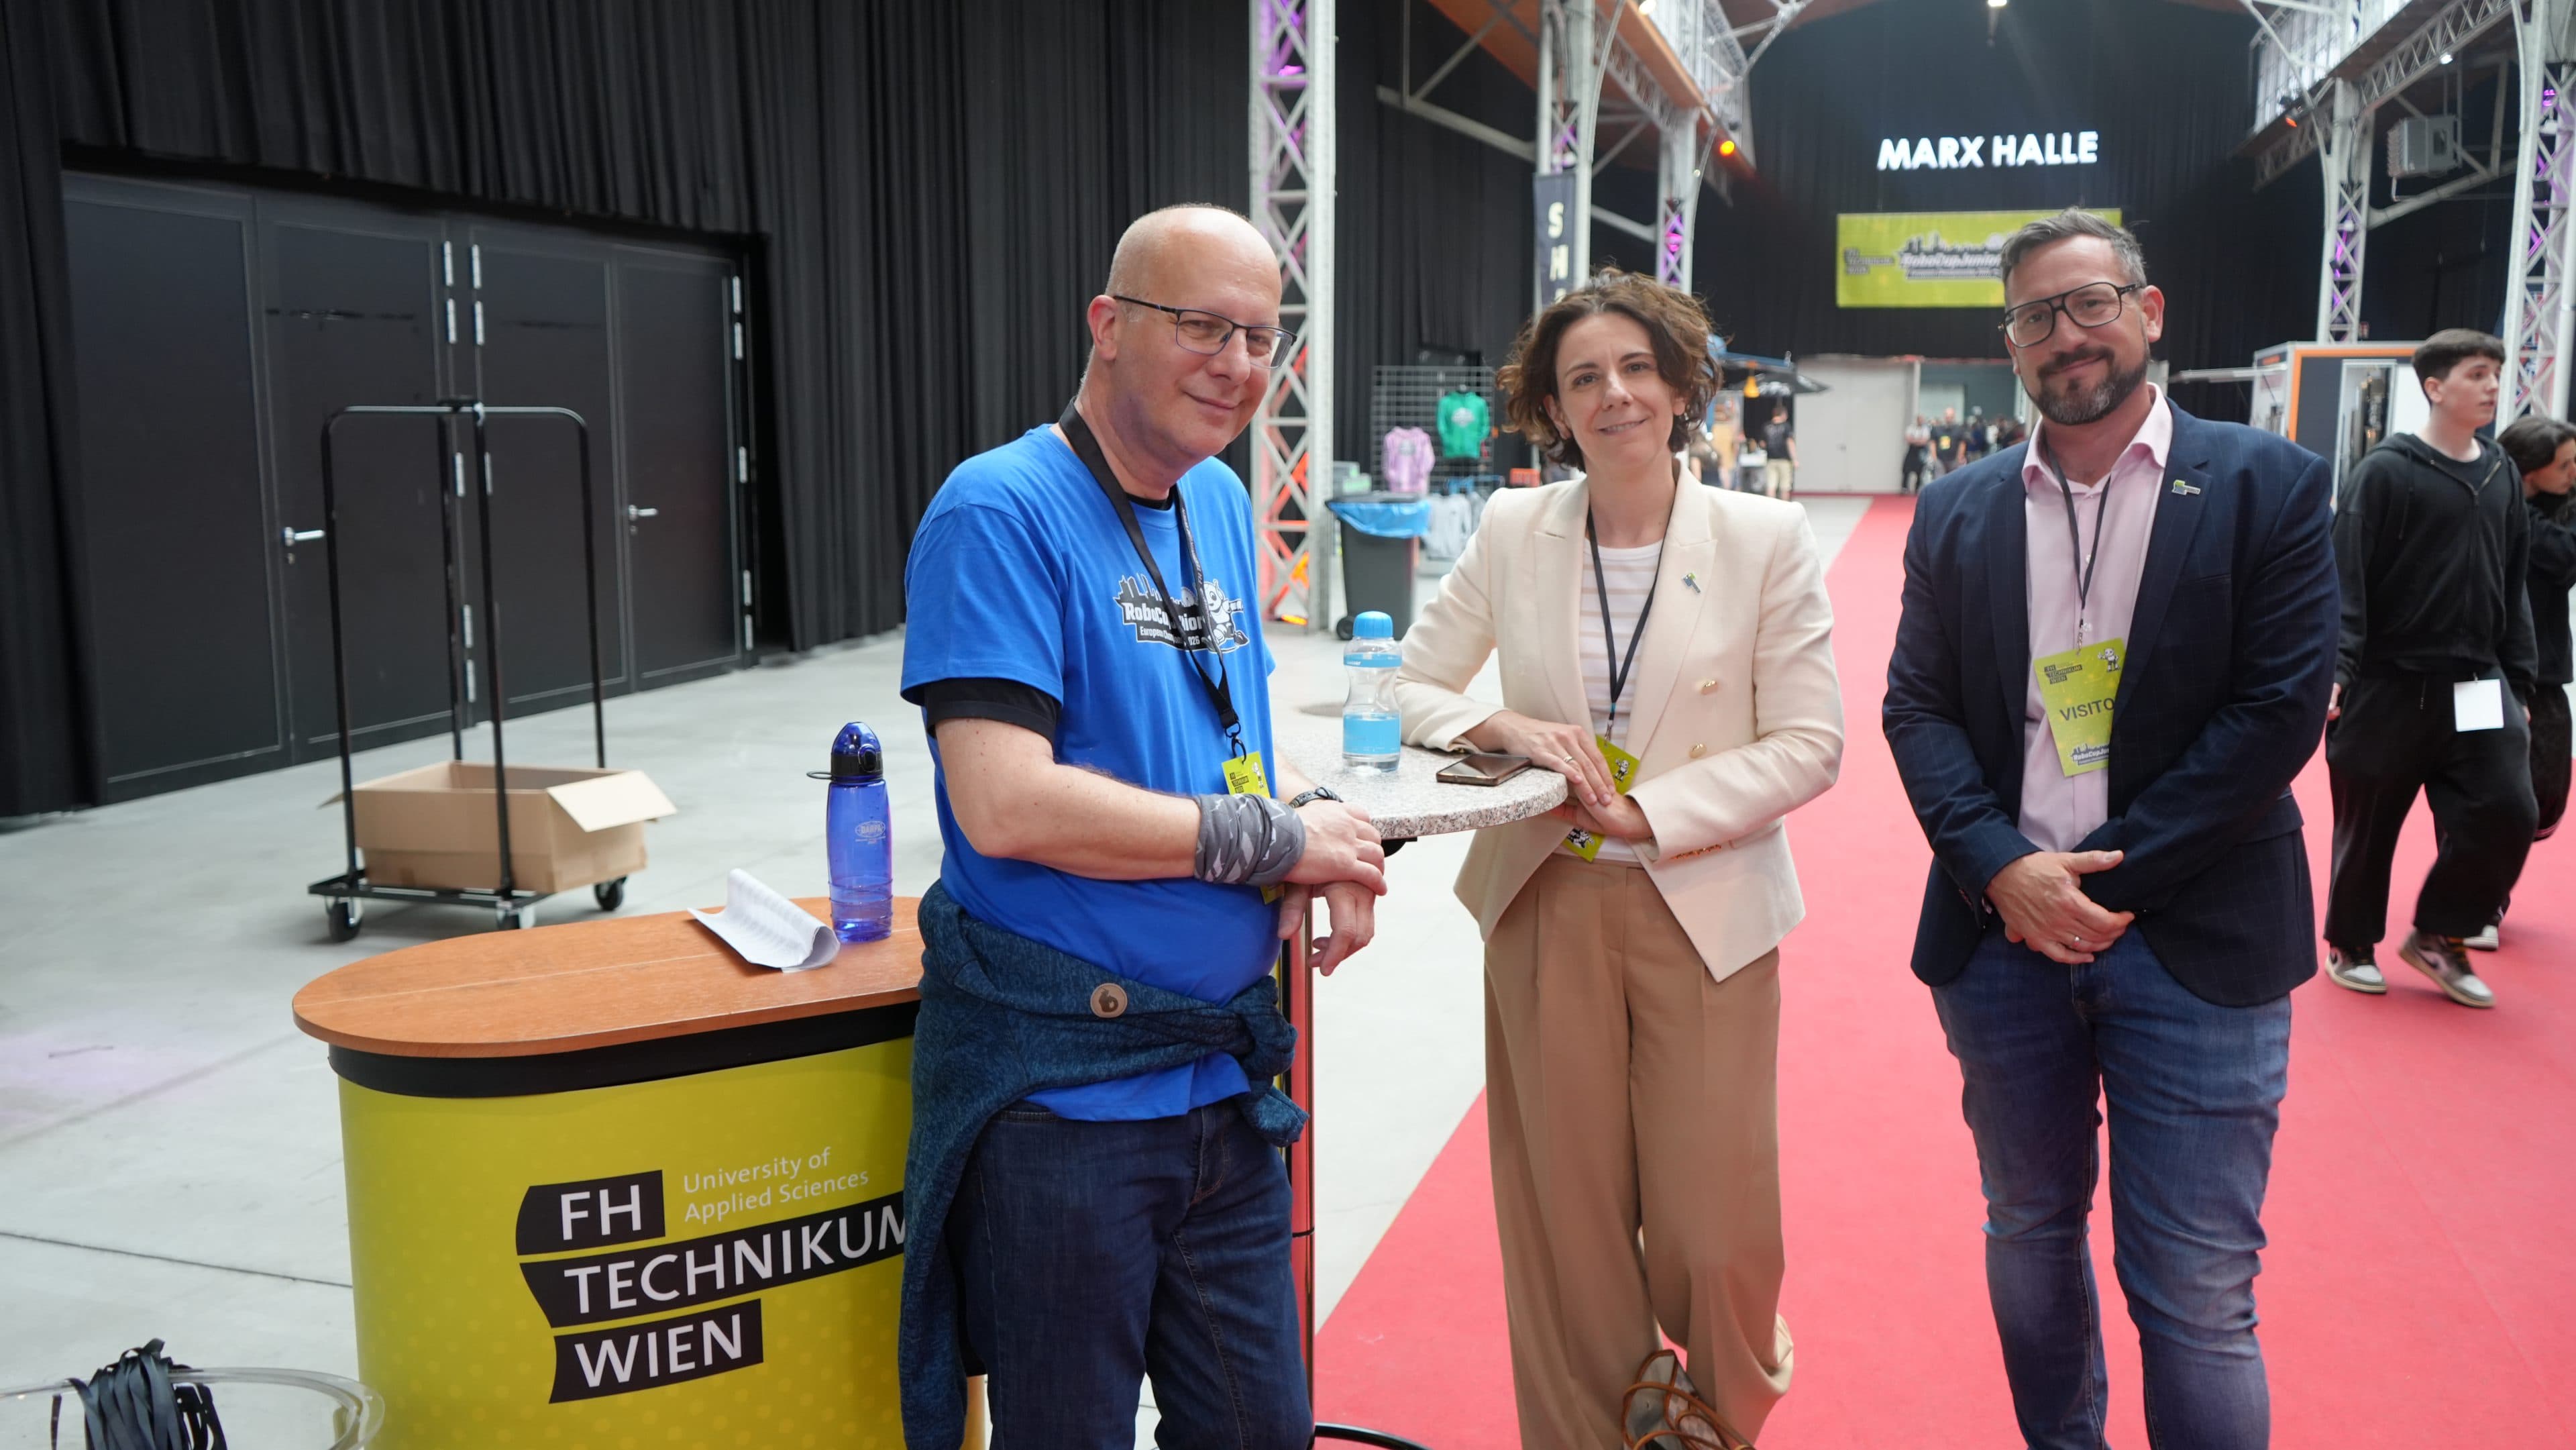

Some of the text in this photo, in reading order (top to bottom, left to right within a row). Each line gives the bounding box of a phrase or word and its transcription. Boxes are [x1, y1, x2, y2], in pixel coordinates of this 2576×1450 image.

[1878, 131, 2098, 170] MARX HALLE
[684, 1147, 831, 1193] University of
[684, 1170, 869, 1225] Applied Sciences
[561, 1184, 641, 1241] FH
[564, 1204, 906, 1314] TECHNIKUM
[574, 1314, 742, 1388] WIEN
